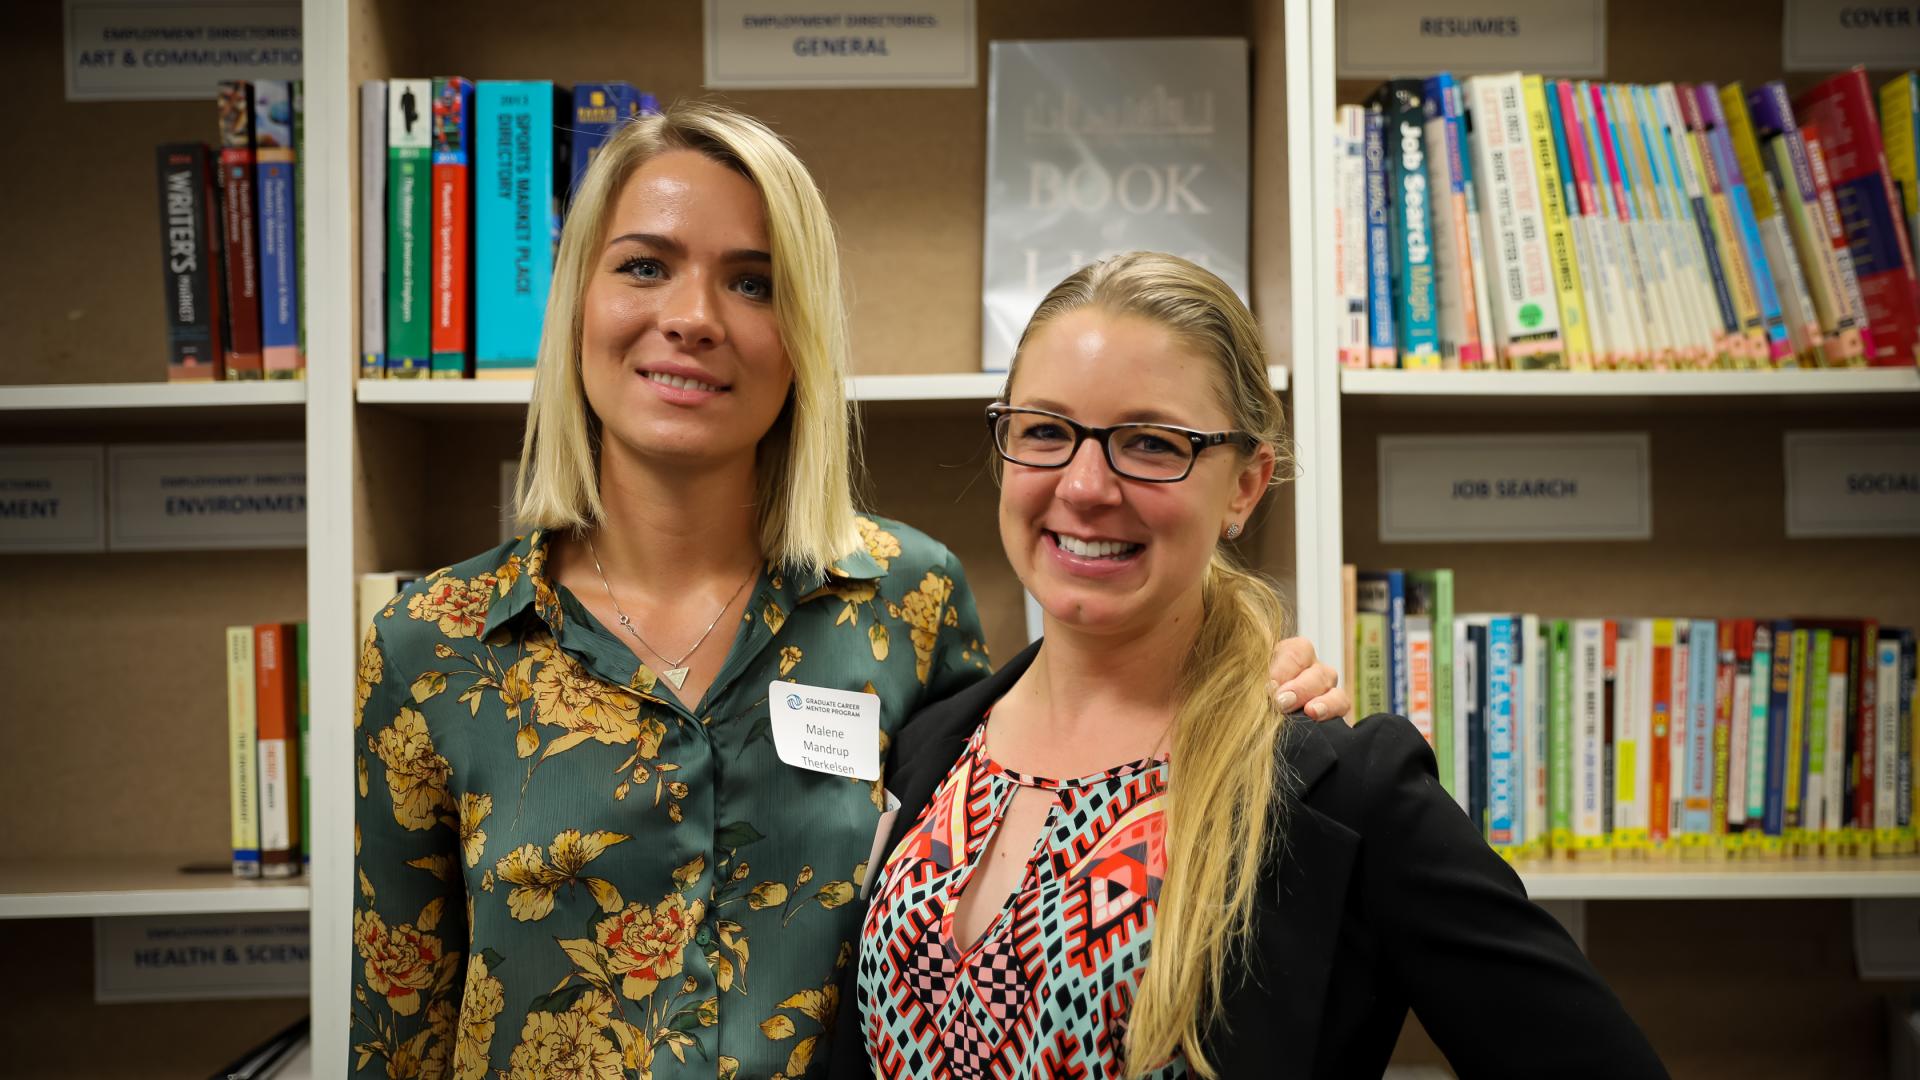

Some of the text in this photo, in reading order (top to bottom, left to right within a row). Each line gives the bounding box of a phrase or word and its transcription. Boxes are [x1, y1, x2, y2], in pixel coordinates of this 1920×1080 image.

[1420, 16, 1519, 37] RESUMES
[1840, 8, 1911, 28] COVER
[793, 35, 889, 57] GENERAL
[80, 49, 115, 67] ART
[123, 48, 138, 67] &
[498, 112, 512, 200] DIRECTORY
[1028, 161, 1211, 215] BOOK
[516, 112, 531, 296] SPORTS MARKET PLACE
[1367, 174, 1385, 226] IMPACT
[167, 170, 196, 273] WRITER'S
[1400, 122, 1432, 322] Job Search Magic
[1451, 479, 1577, 499] JOB SEARCH
[805, 697, 860, 710] GRADUATE CAREER
[805, 705, 861, 717] MENTOR PROGRAM
[806, 723, 844, 739] Malene
[803, 740, 849, 759] Mandrup
[801, 756, 855, 775] Therkelsen
[1490, 759, 1512, 824] BOOK
[134, 947, 216, 968] HEALTH
[223, 944, 240, 964] &
